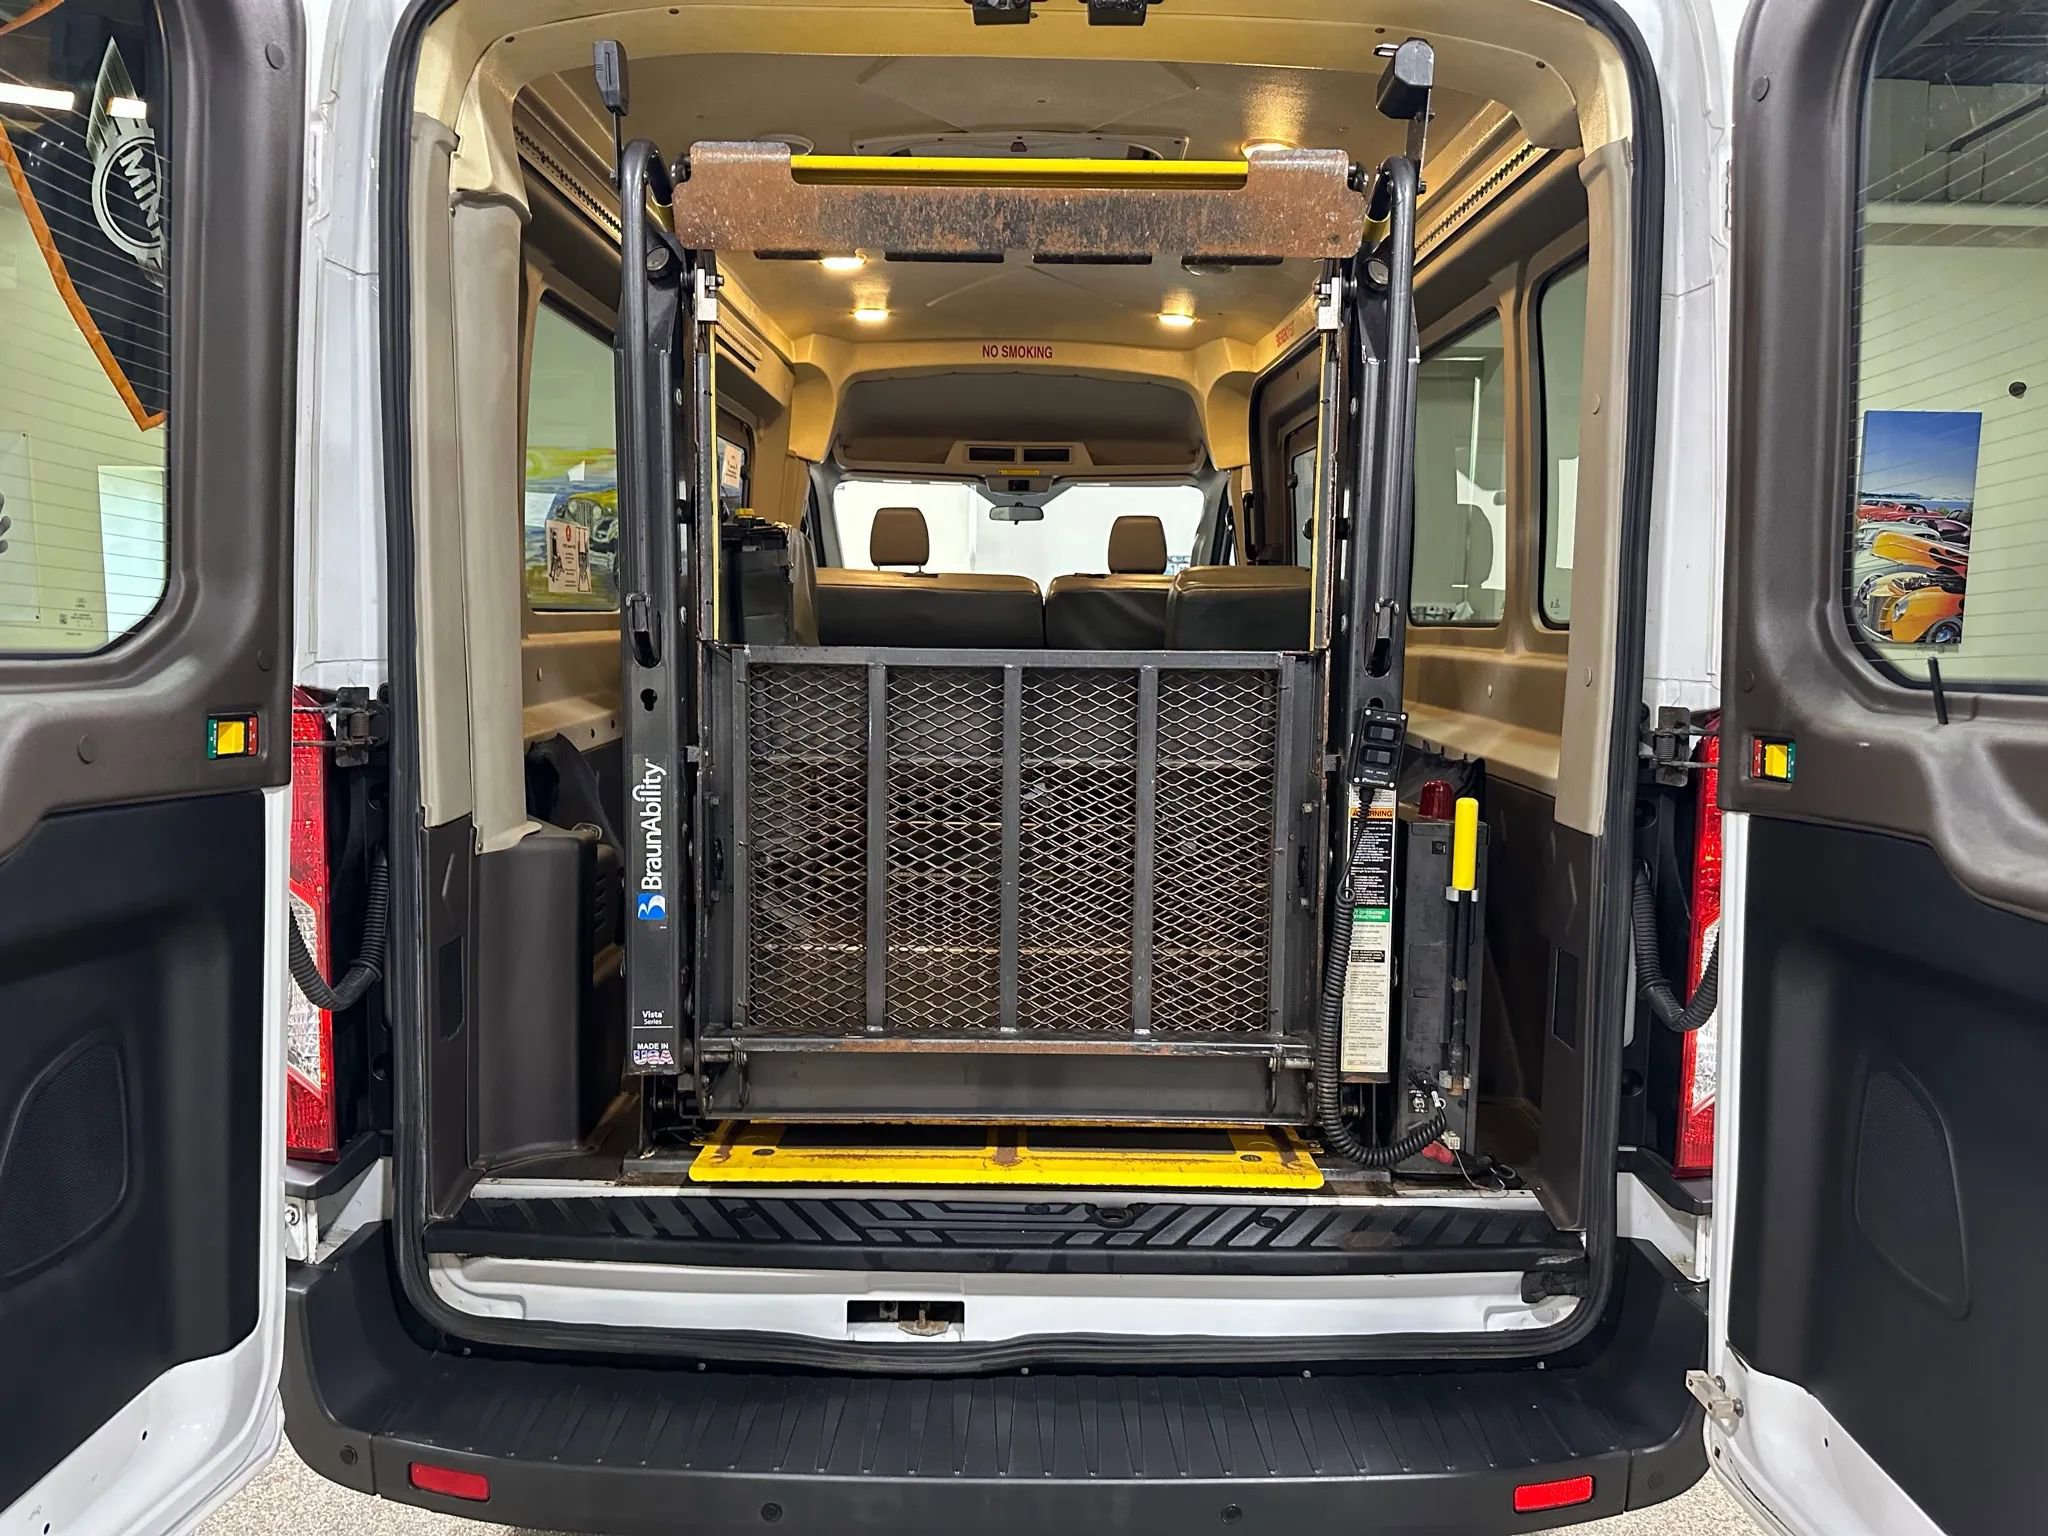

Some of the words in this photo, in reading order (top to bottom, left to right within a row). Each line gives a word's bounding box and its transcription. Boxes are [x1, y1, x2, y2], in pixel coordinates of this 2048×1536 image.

[982, 344, 999, 358] NO
[1001, 345, 1053, 359] SMOKING
[633, 760, 667, 890] BraunAbility
[642, 1010, 663, 1018] Vista
[633, 1050, 675, 1065] USA
